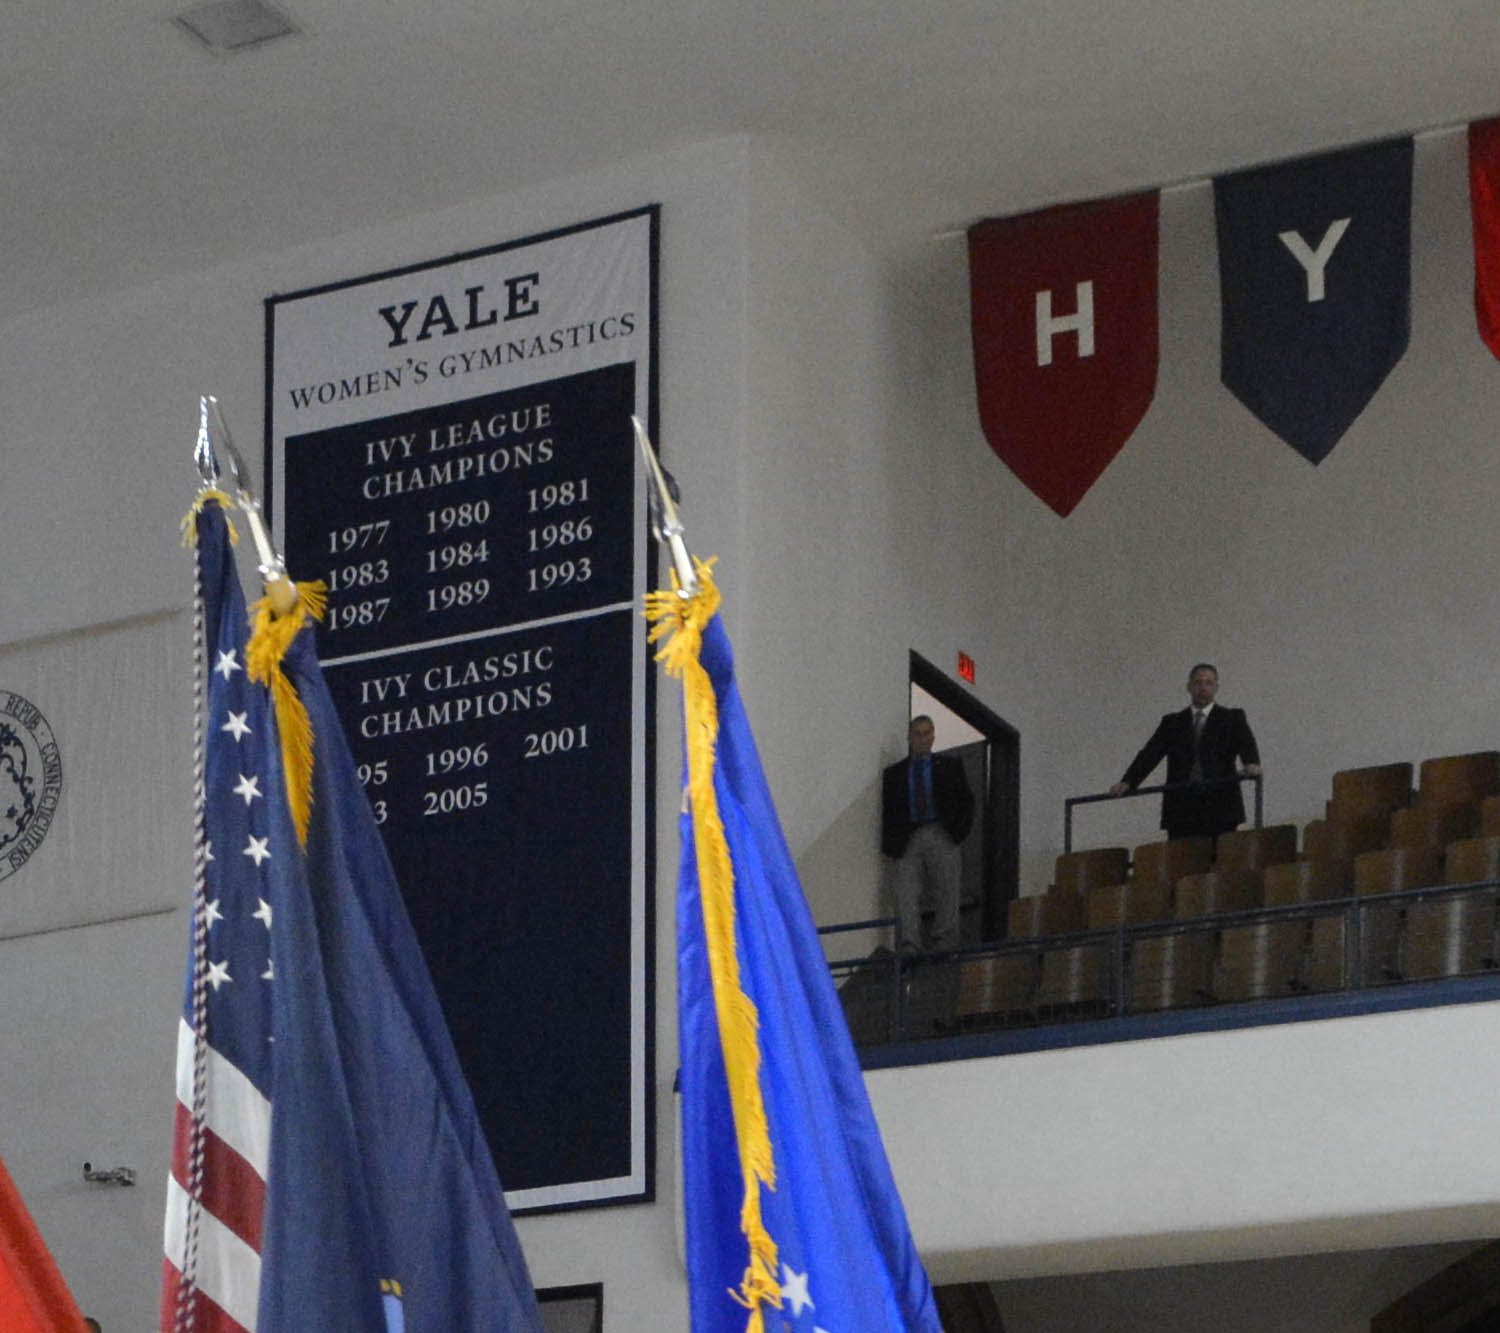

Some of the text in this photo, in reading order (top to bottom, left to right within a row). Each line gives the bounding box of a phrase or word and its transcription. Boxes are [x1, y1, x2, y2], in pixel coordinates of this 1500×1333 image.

[1278, 218, 1352, 303] Y
[378, 272, 540, 349] YALE
[1034, 280, 1096, 367] H
[289, 312, 636, 410] WOMEN'S GYMNASTICS
[365, 403, 551, 465] IVY LEAGUE
[362, 437, 554, 500] CHAMPIONS
[328, 477, 589, 554] 1977 1980 1981
[329, 515, 593, 592] 1983 1984 1986
[328, 557, 592, 631] 1987 1989 1993
[360, 646, 553, 704] IVY CLASSIC
[5, 694, 42, 731] REPUB
[360, 682, 552, 738] CHAMPIONS
[357, 724, 589, 785] 95 1996 2001
[423, 782, 488, 815] 2005
